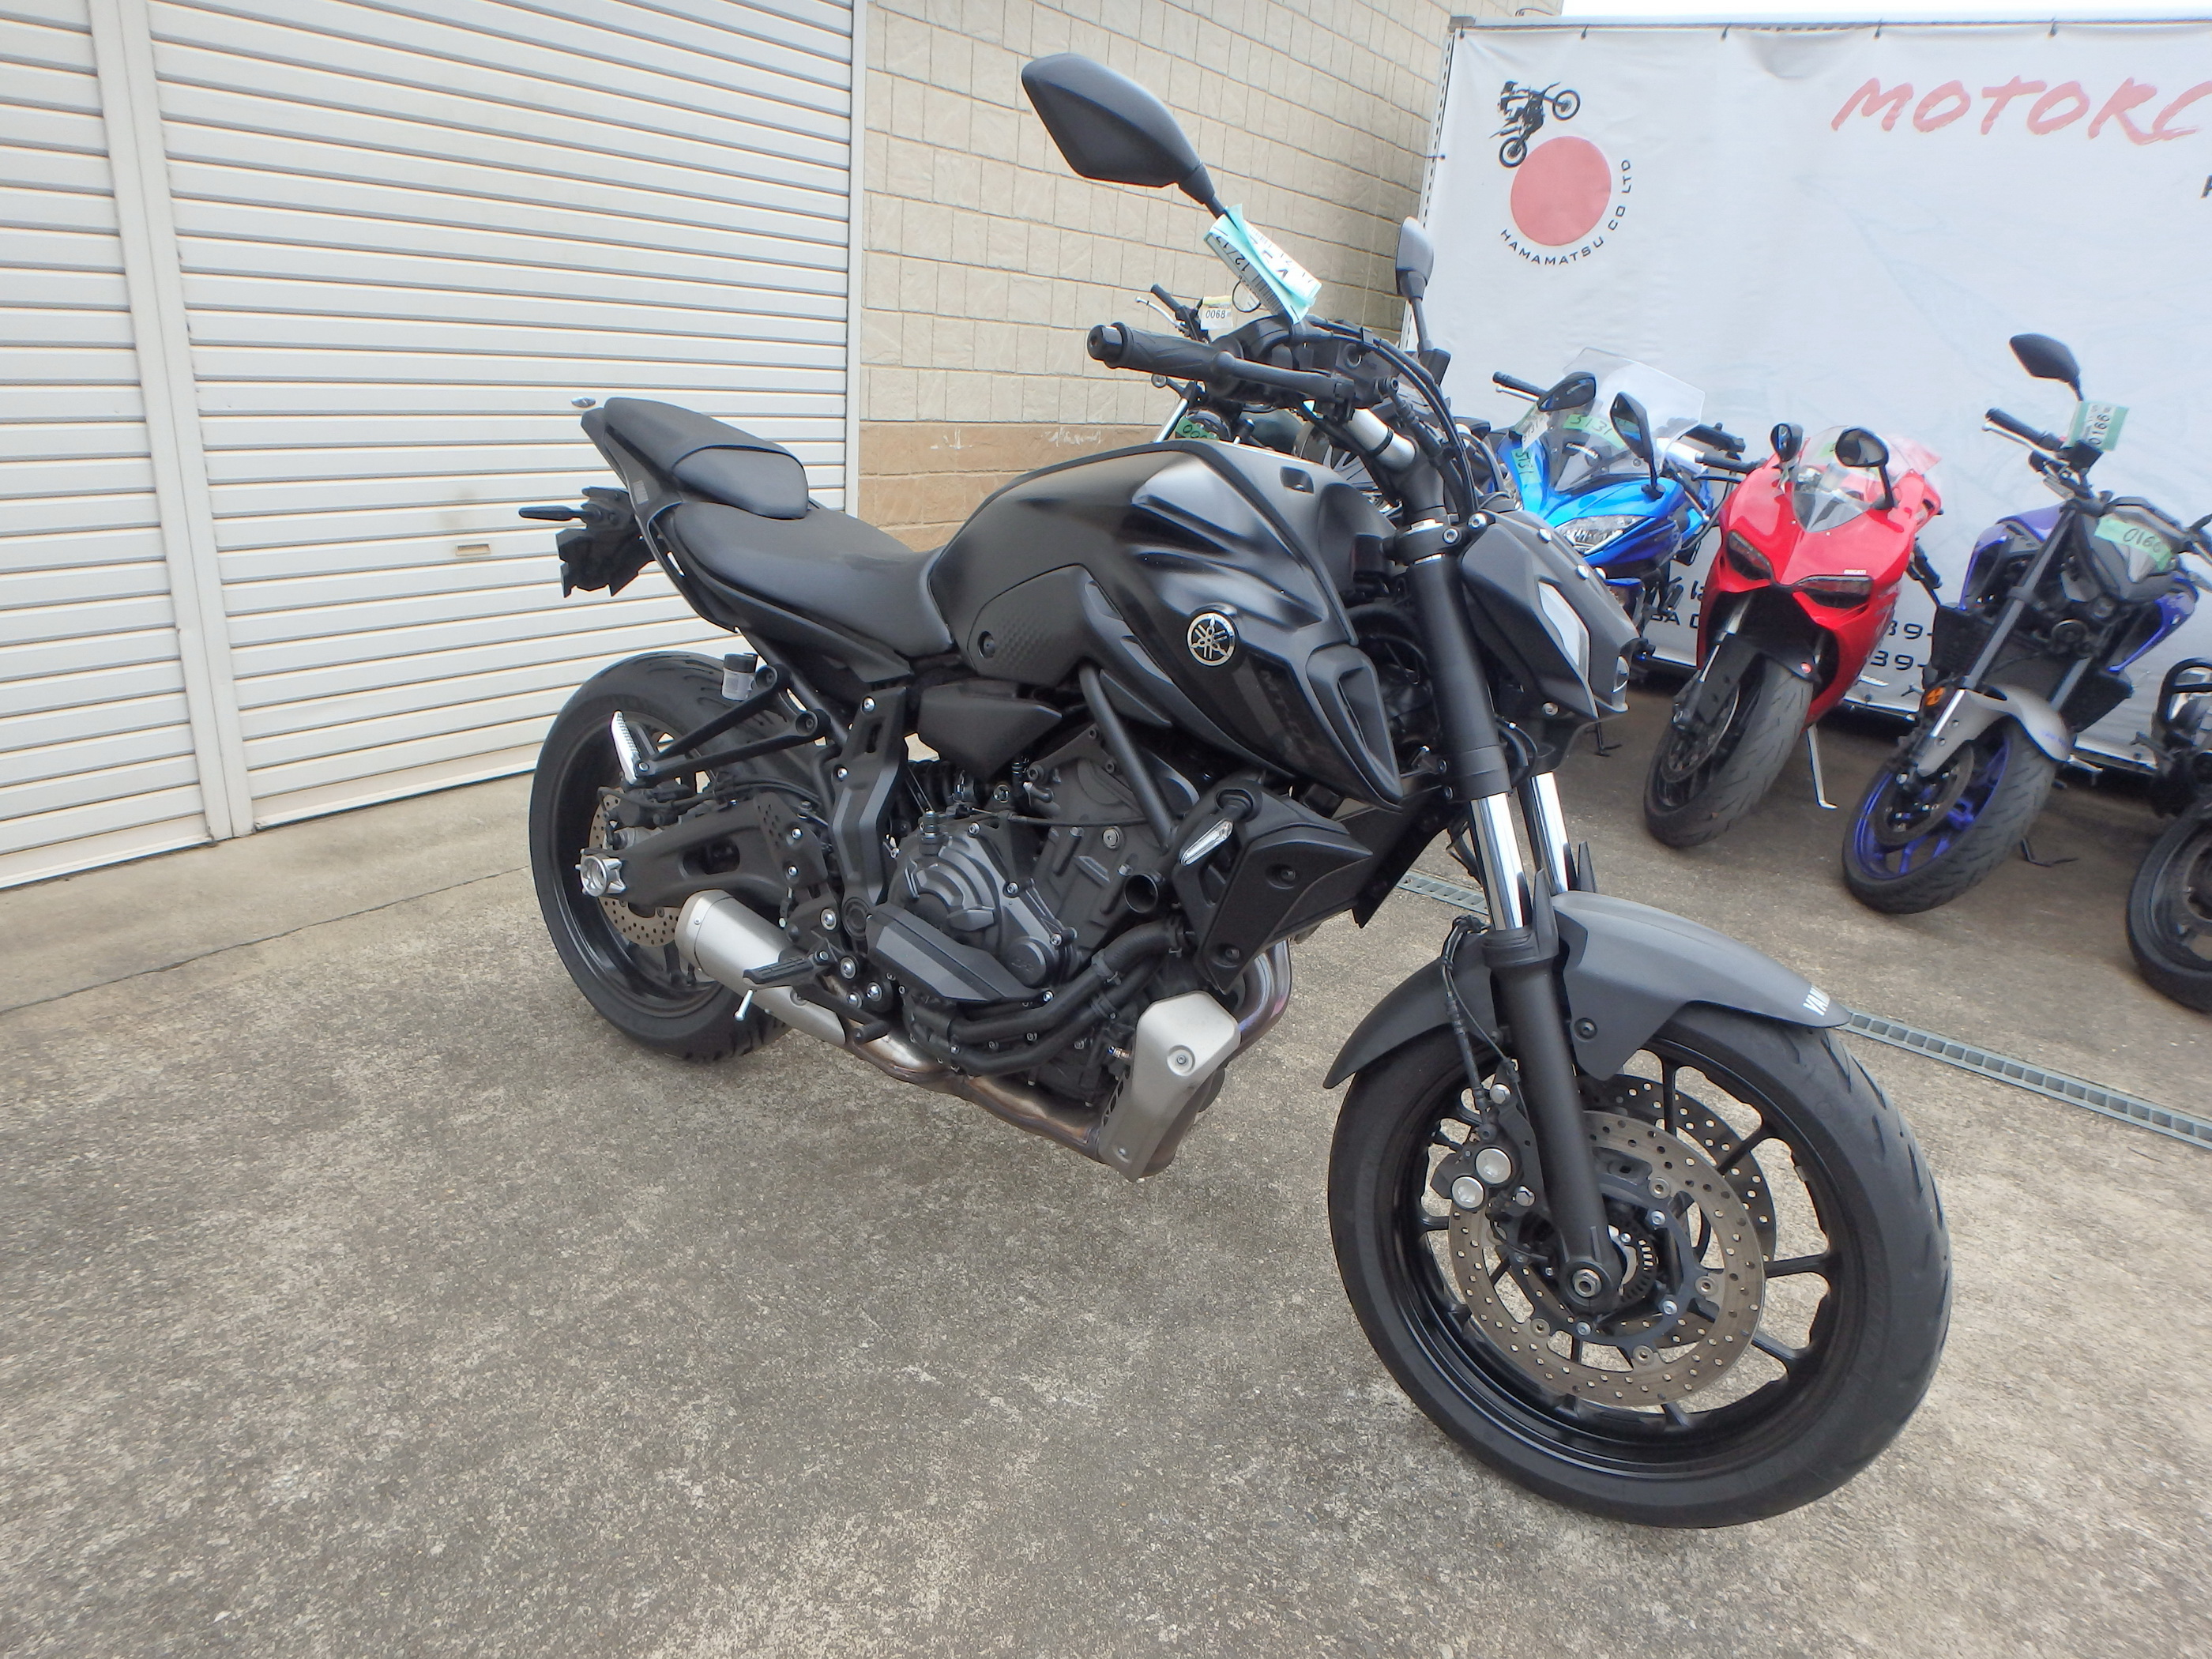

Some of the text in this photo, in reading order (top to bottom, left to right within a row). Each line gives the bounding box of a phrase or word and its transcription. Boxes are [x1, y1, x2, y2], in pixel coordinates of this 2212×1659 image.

[1500, 159, 1633, 265] HAMAMATSU CO LTD
[1206, 309, 1226, 319] 0068
